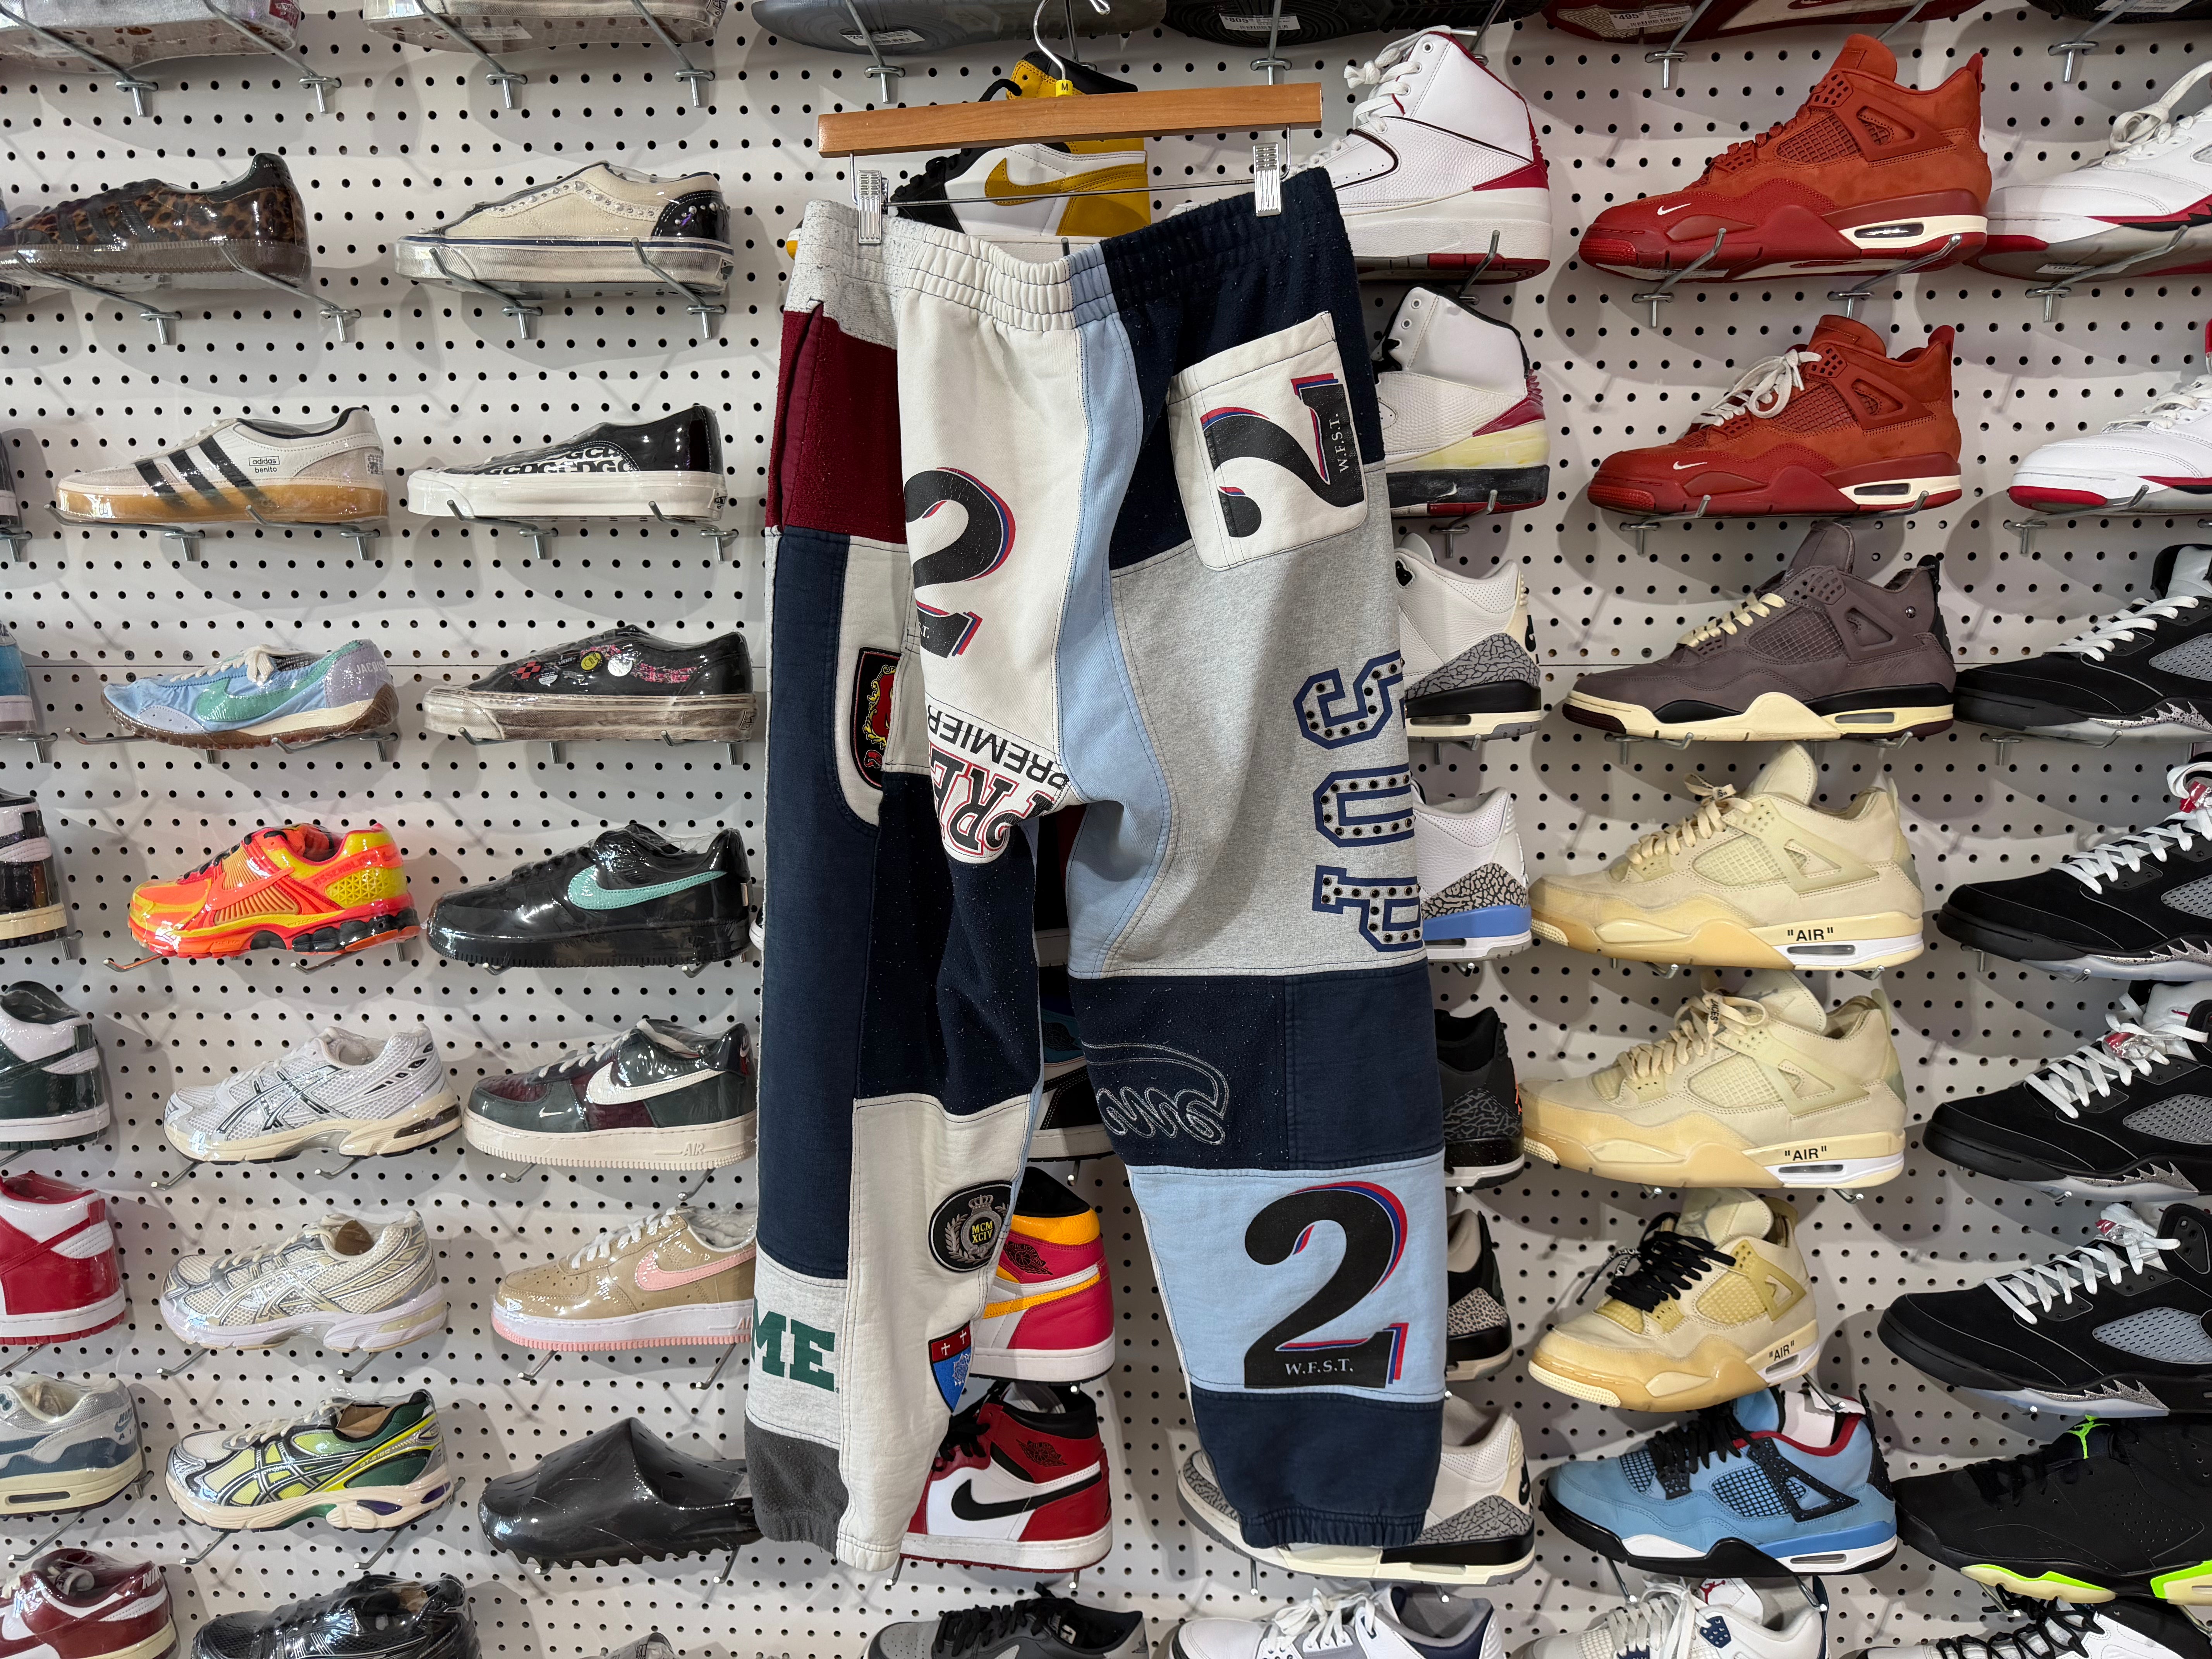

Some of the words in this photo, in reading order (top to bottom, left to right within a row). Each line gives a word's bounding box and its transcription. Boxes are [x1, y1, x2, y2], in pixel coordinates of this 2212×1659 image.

[1061, 82, 1068, 91] M
[1329, 412, 1349, 473] W.F.S.T.
[927, 704, 1070, 790] PREMIER
[1787, 926, 1834, 941] "AIR"
[681, 1142, 705, 1156] AIR
[1784, 1145, 1827, 1161] "AIR"
[972, 1220, 993, 1235] MCM
[972, 1229, 993, 1244] XCIV
[1244, 1181, 1409, 1389] 2
[1769, 1340, 1794, 1361] "AIR"
[1285, 1358, 1354, 1376] W.F.S.T.
